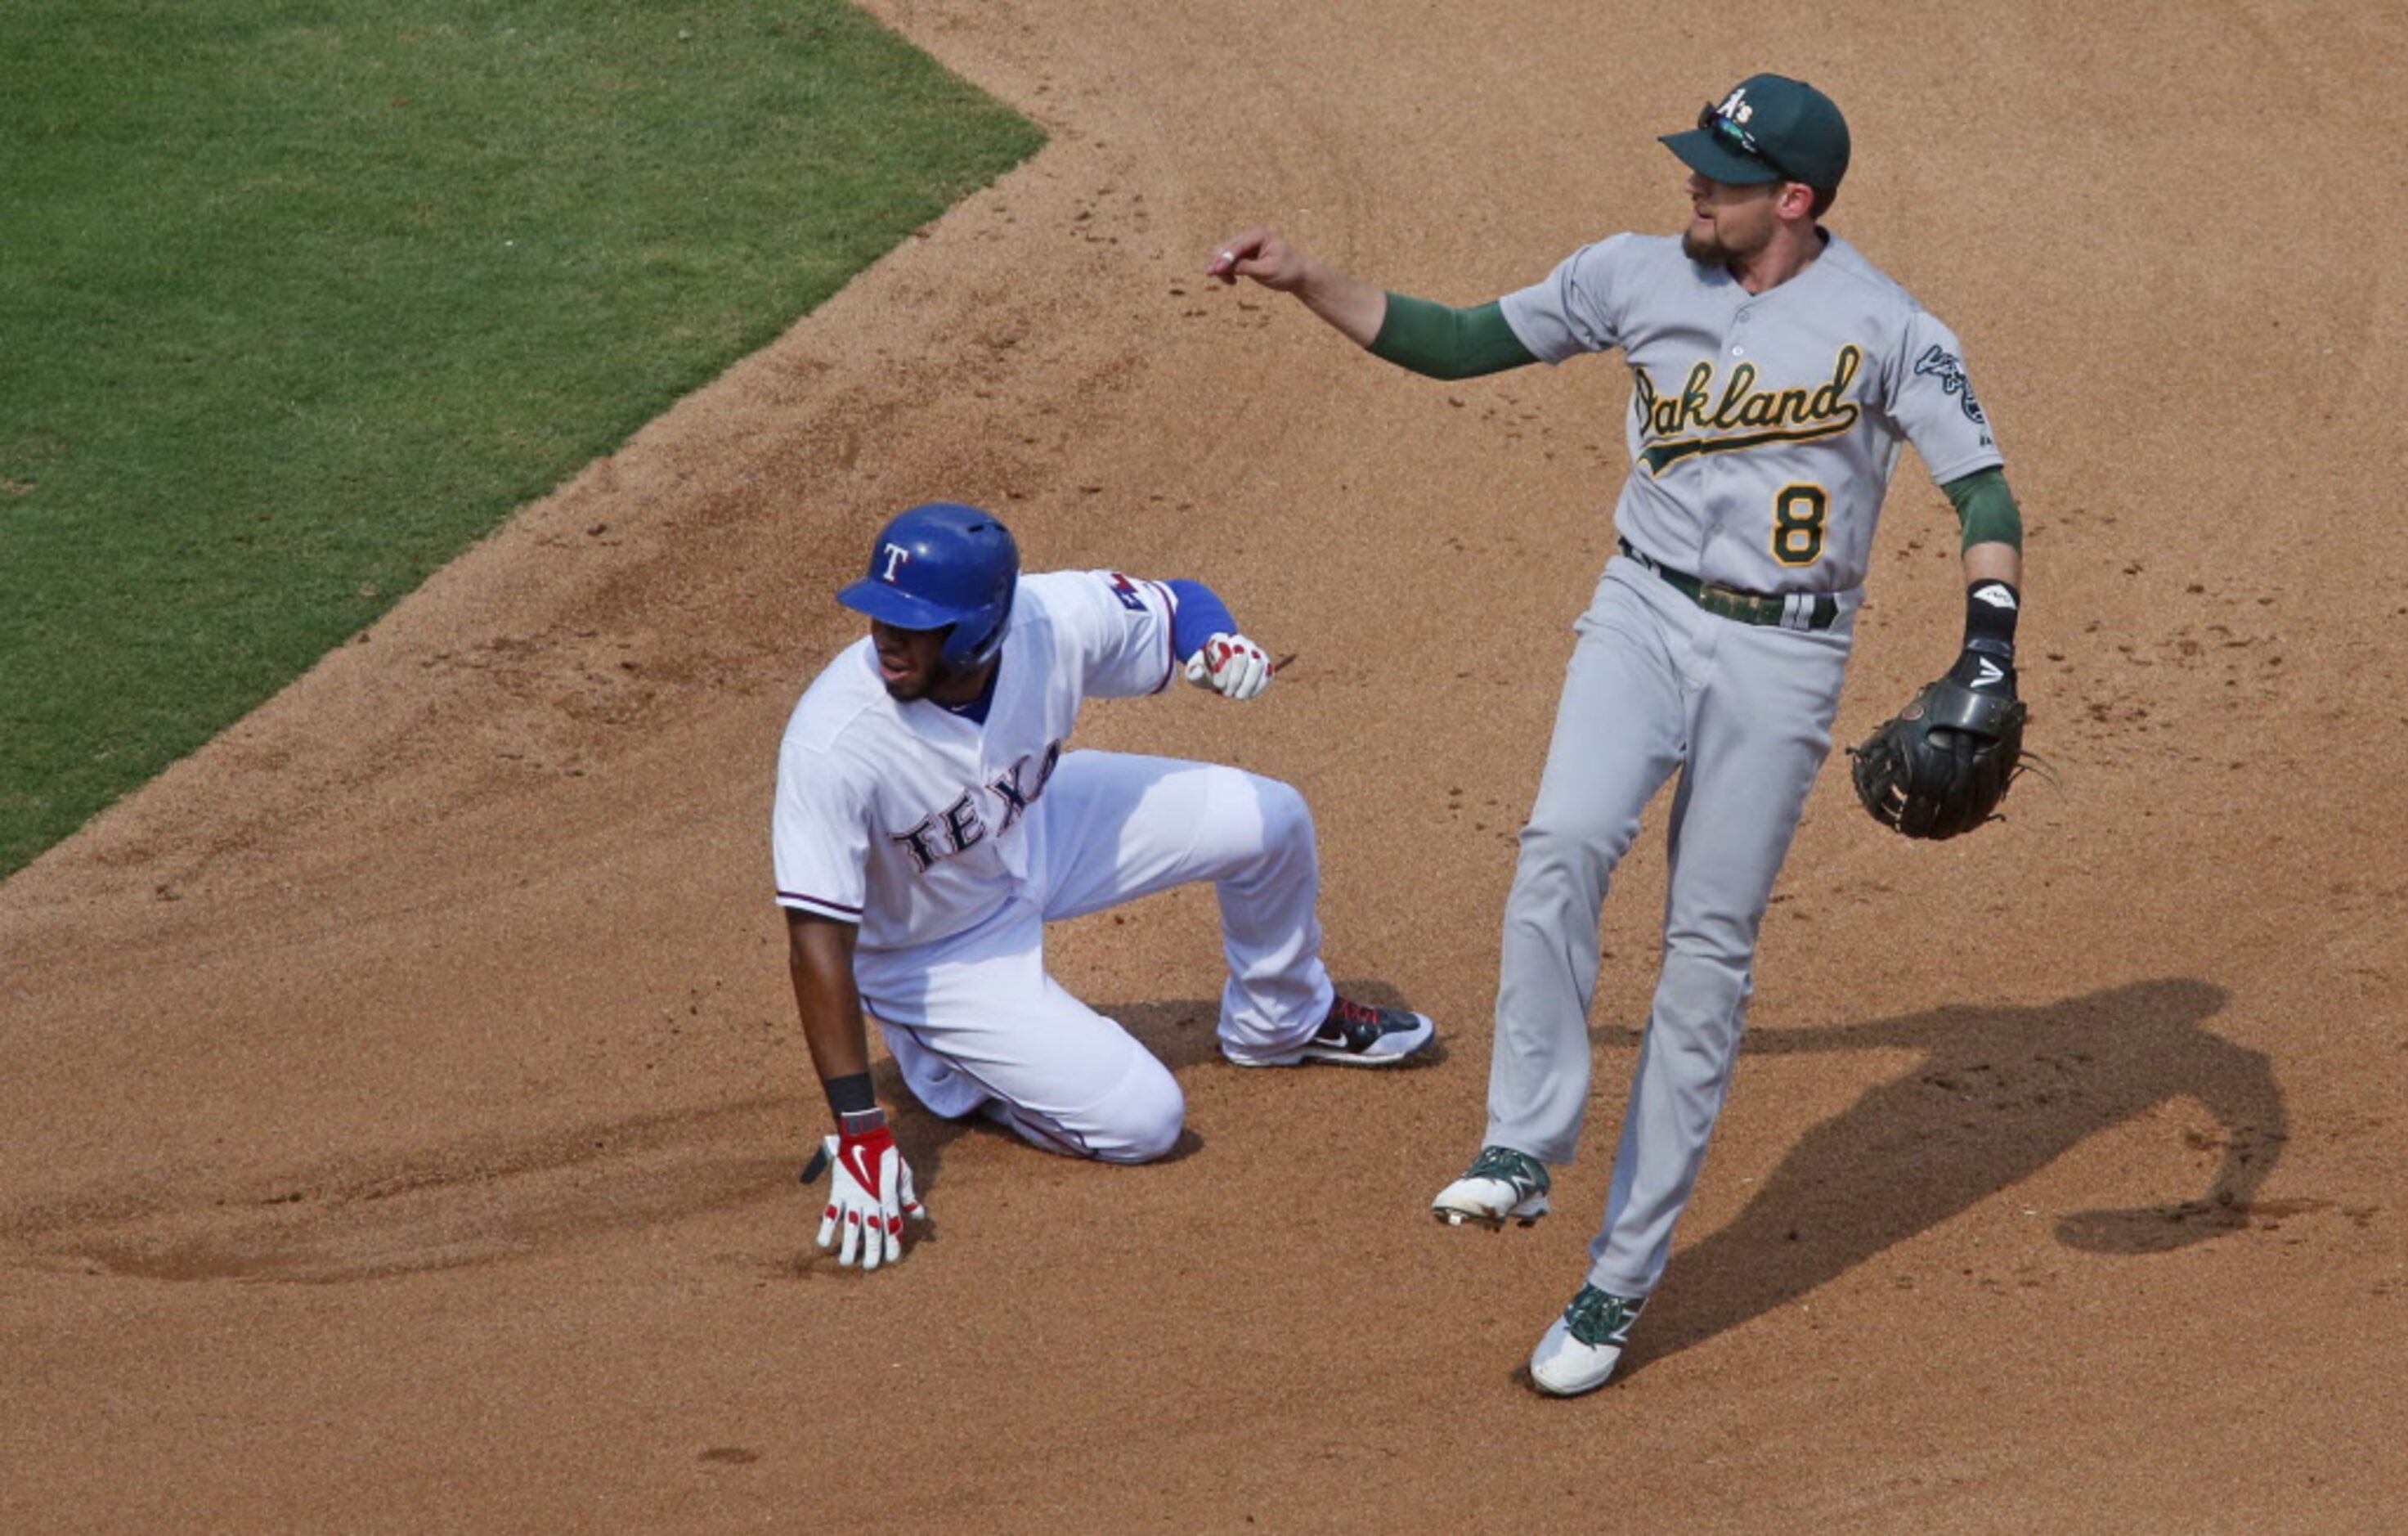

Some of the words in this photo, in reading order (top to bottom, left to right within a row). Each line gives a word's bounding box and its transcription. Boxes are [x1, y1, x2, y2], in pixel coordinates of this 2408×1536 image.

[1716, 88, 1753, 124] A's
[1634, 344, 1861, 440] Oakland
[1769, 483, 1828, 568] 8
[884, 542, 909, 582] T
